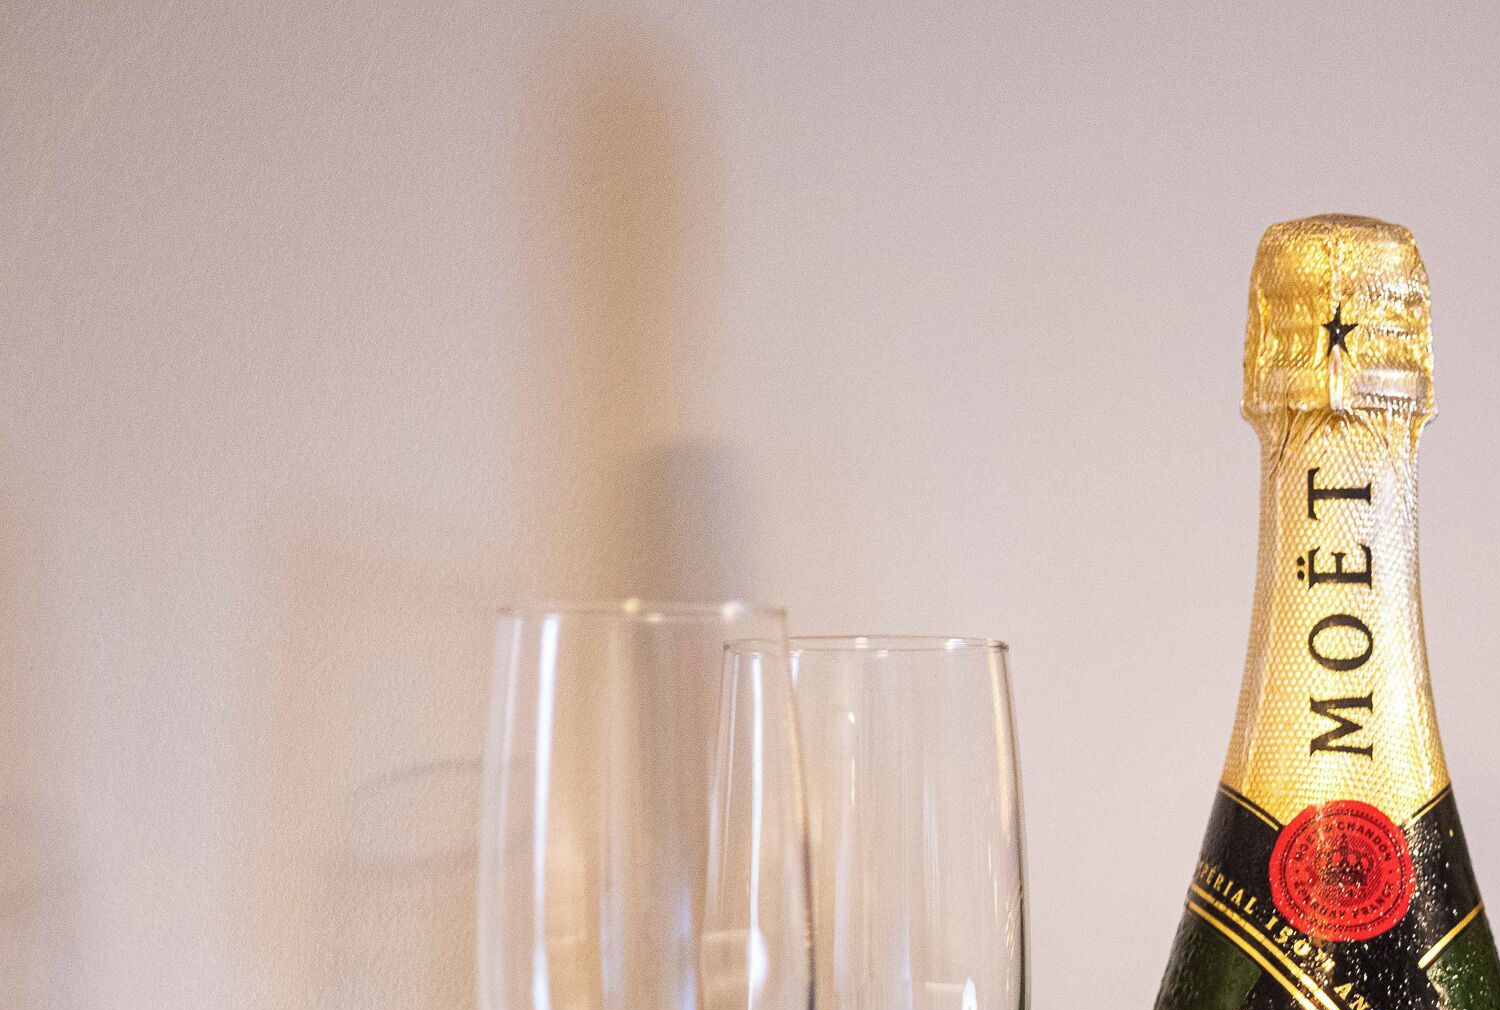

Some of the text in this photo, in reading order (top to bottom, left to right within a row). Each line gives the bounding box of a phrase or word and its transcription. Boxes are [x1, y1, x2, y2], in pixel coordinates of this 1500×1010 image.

[1296, 467, 1374, 759] MOËT
[1336, 820, 1393, 862] CHANDON
[1198, 862, 1258, 915] PÉRIAL
